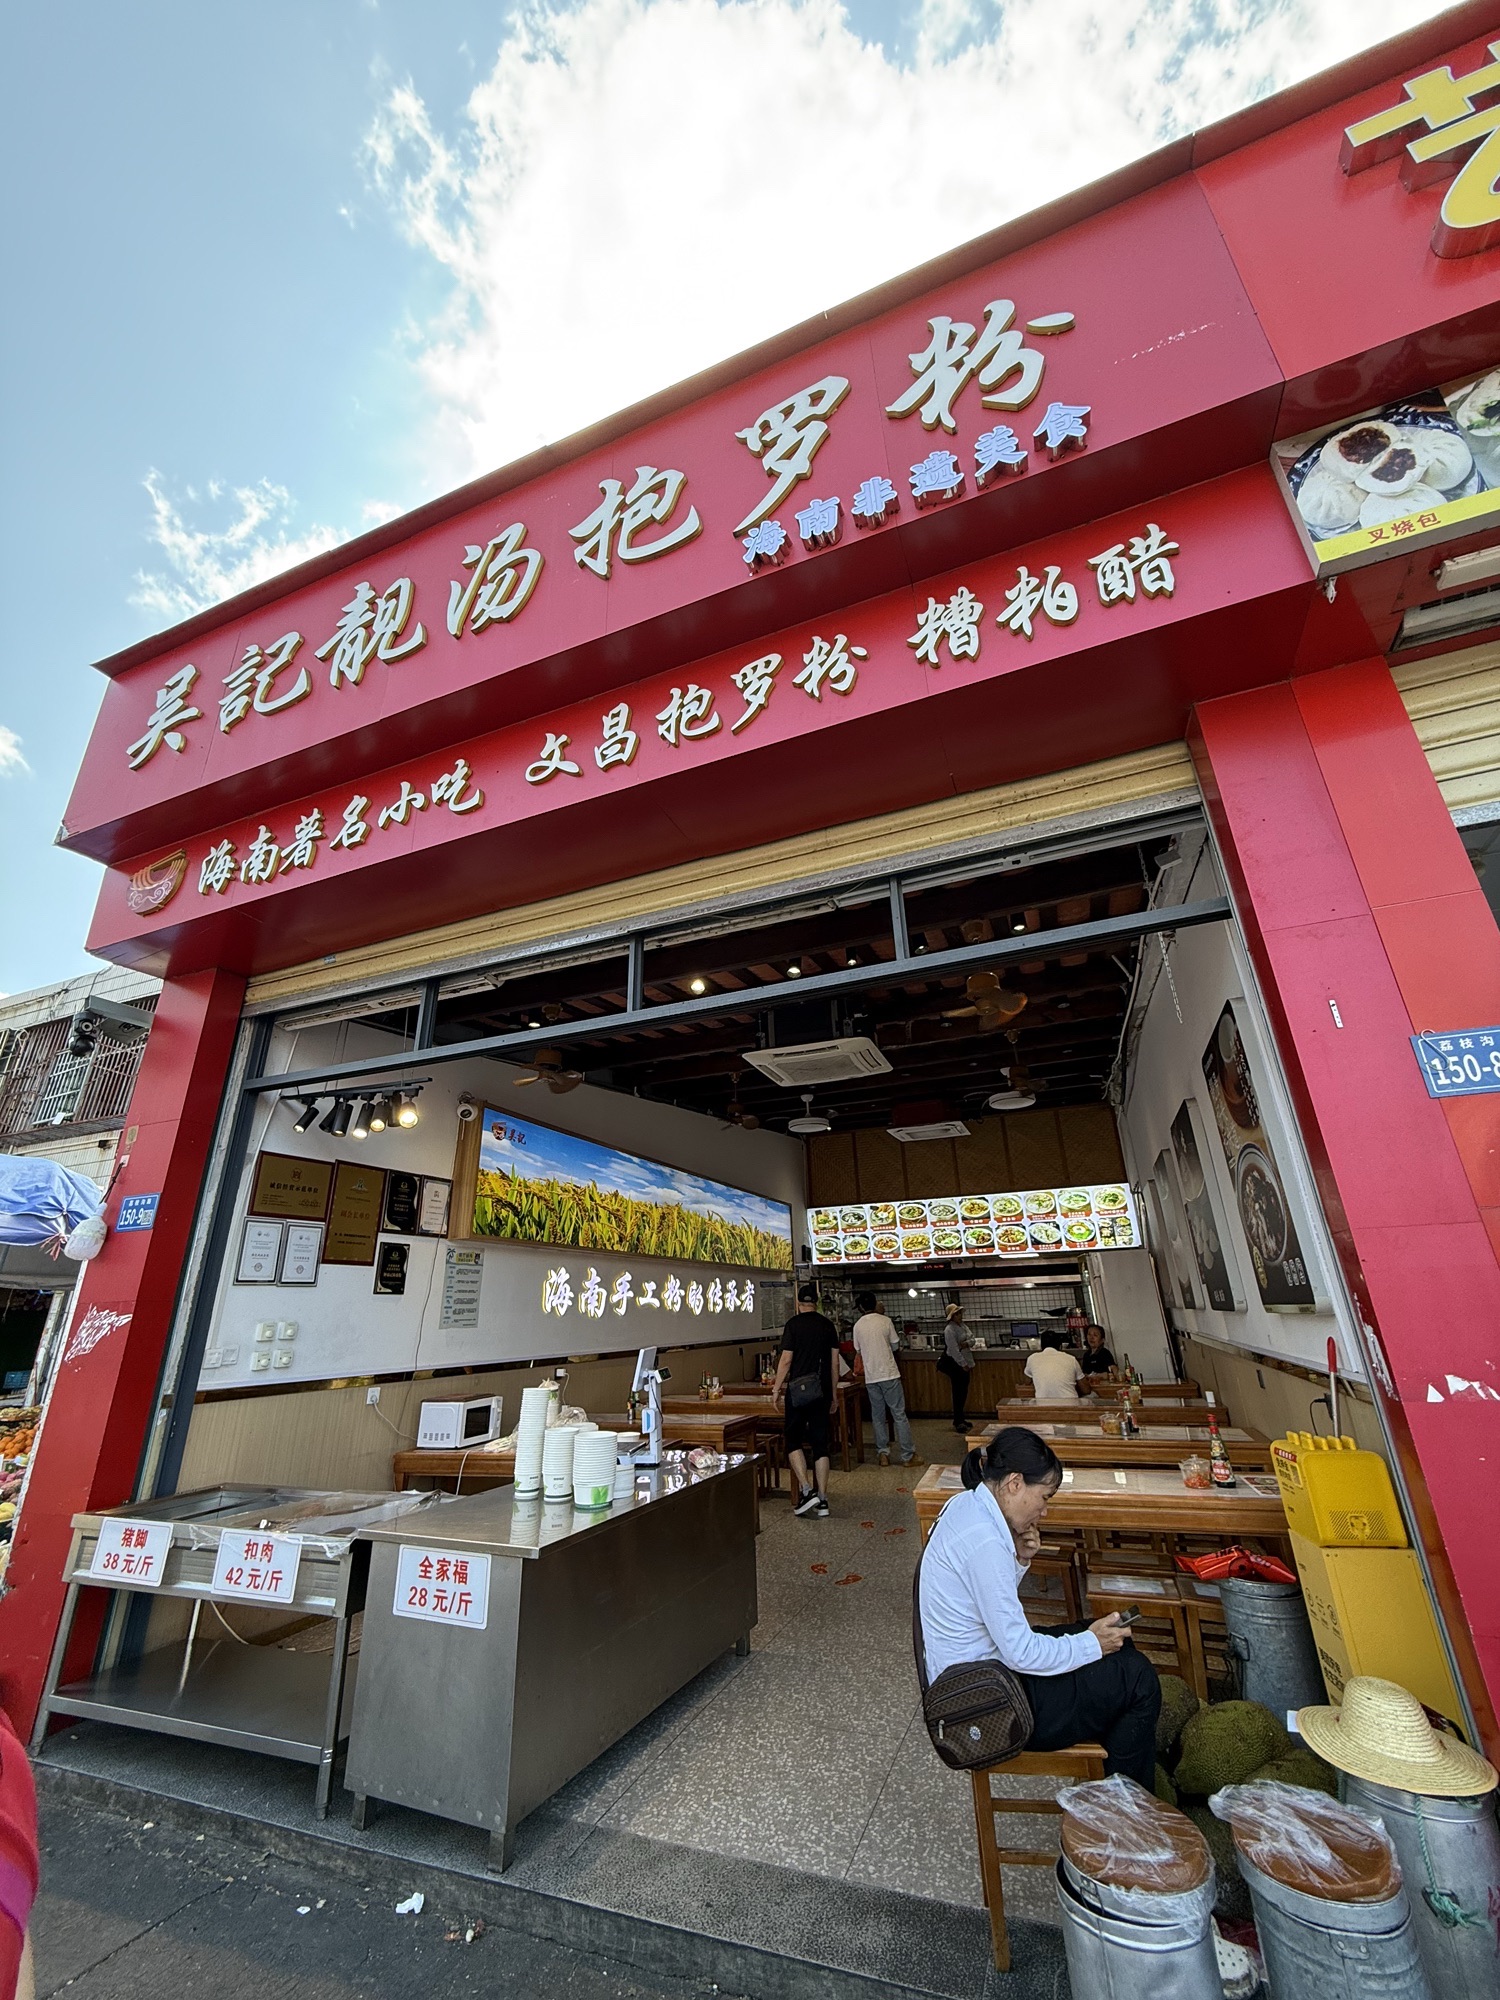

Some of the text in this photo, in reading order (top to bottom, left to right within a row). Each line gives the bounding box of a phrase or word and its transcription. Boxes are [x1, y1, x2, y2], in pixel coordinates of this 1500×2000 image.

[743, 403, 1092, 566] 海南非遗美食
[1368, 512, 1442, 544] 叉烧包
[198, 523, 1180, 895] 海南著名小吃 文昌抱罗粉 糟粕醋
[1439, 1035, 1495, 1052] 荔枝沟
[119, 1207, 144, 1226] 150-9
[542, 1266, 756, 1318] 海南手工粉的传承者
[121, 1527, 149, 1549] 猪脚
[244, 1539, 274, 1563] 扣肉
[418, 1555, 470, 1586] 全家福
